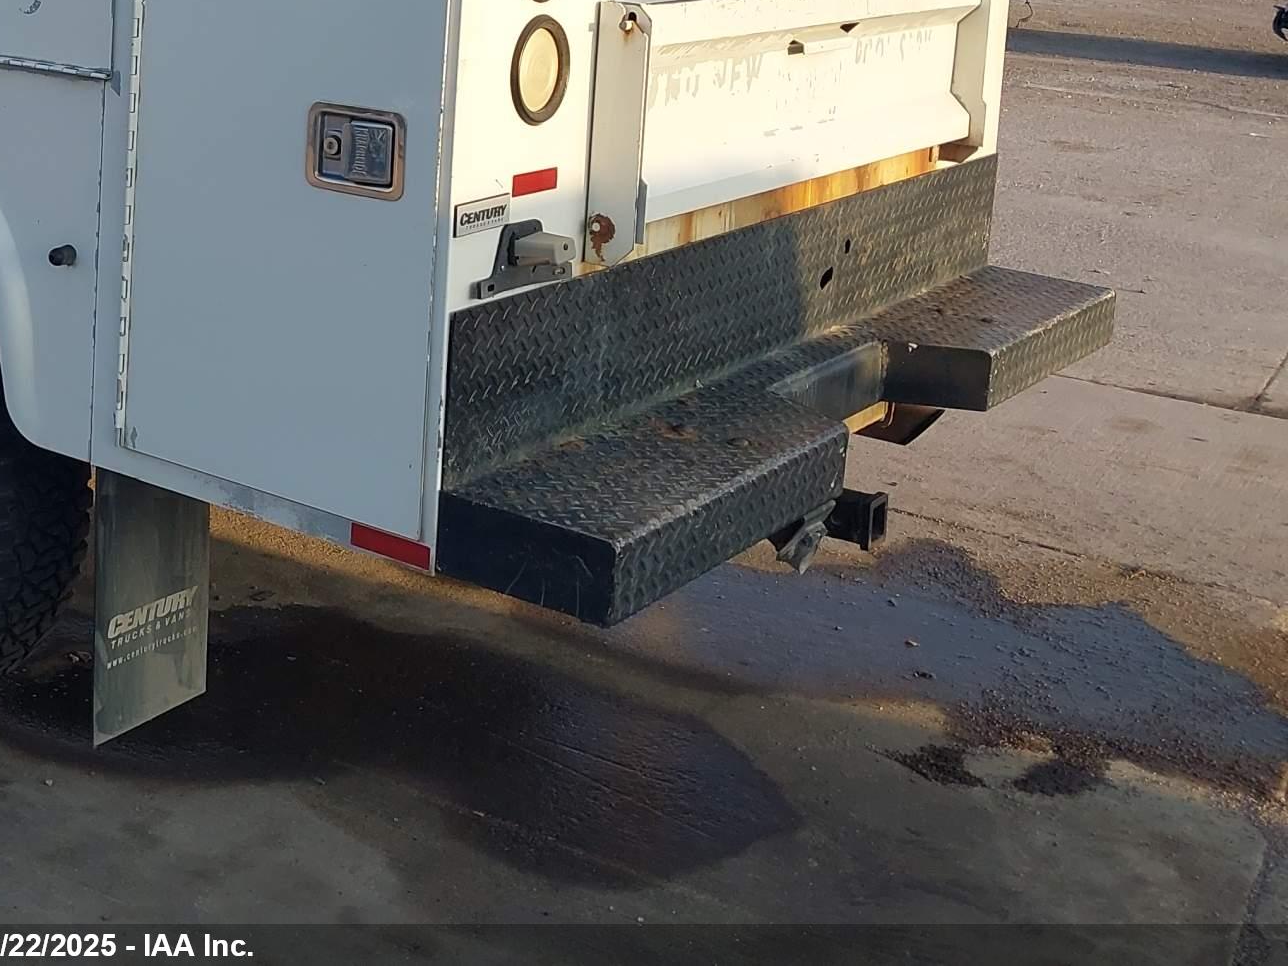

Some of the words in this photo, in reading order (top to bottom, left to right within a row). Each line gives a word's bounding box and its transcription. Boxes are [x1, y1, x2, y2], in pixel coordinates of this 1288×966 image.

[460, 204, 507, 226] CENTURY
[107, 586, 198, 639] CENTURY
[111, 624, 152, 649] TRUCKS
[165, 608, 192, 626] VANS
